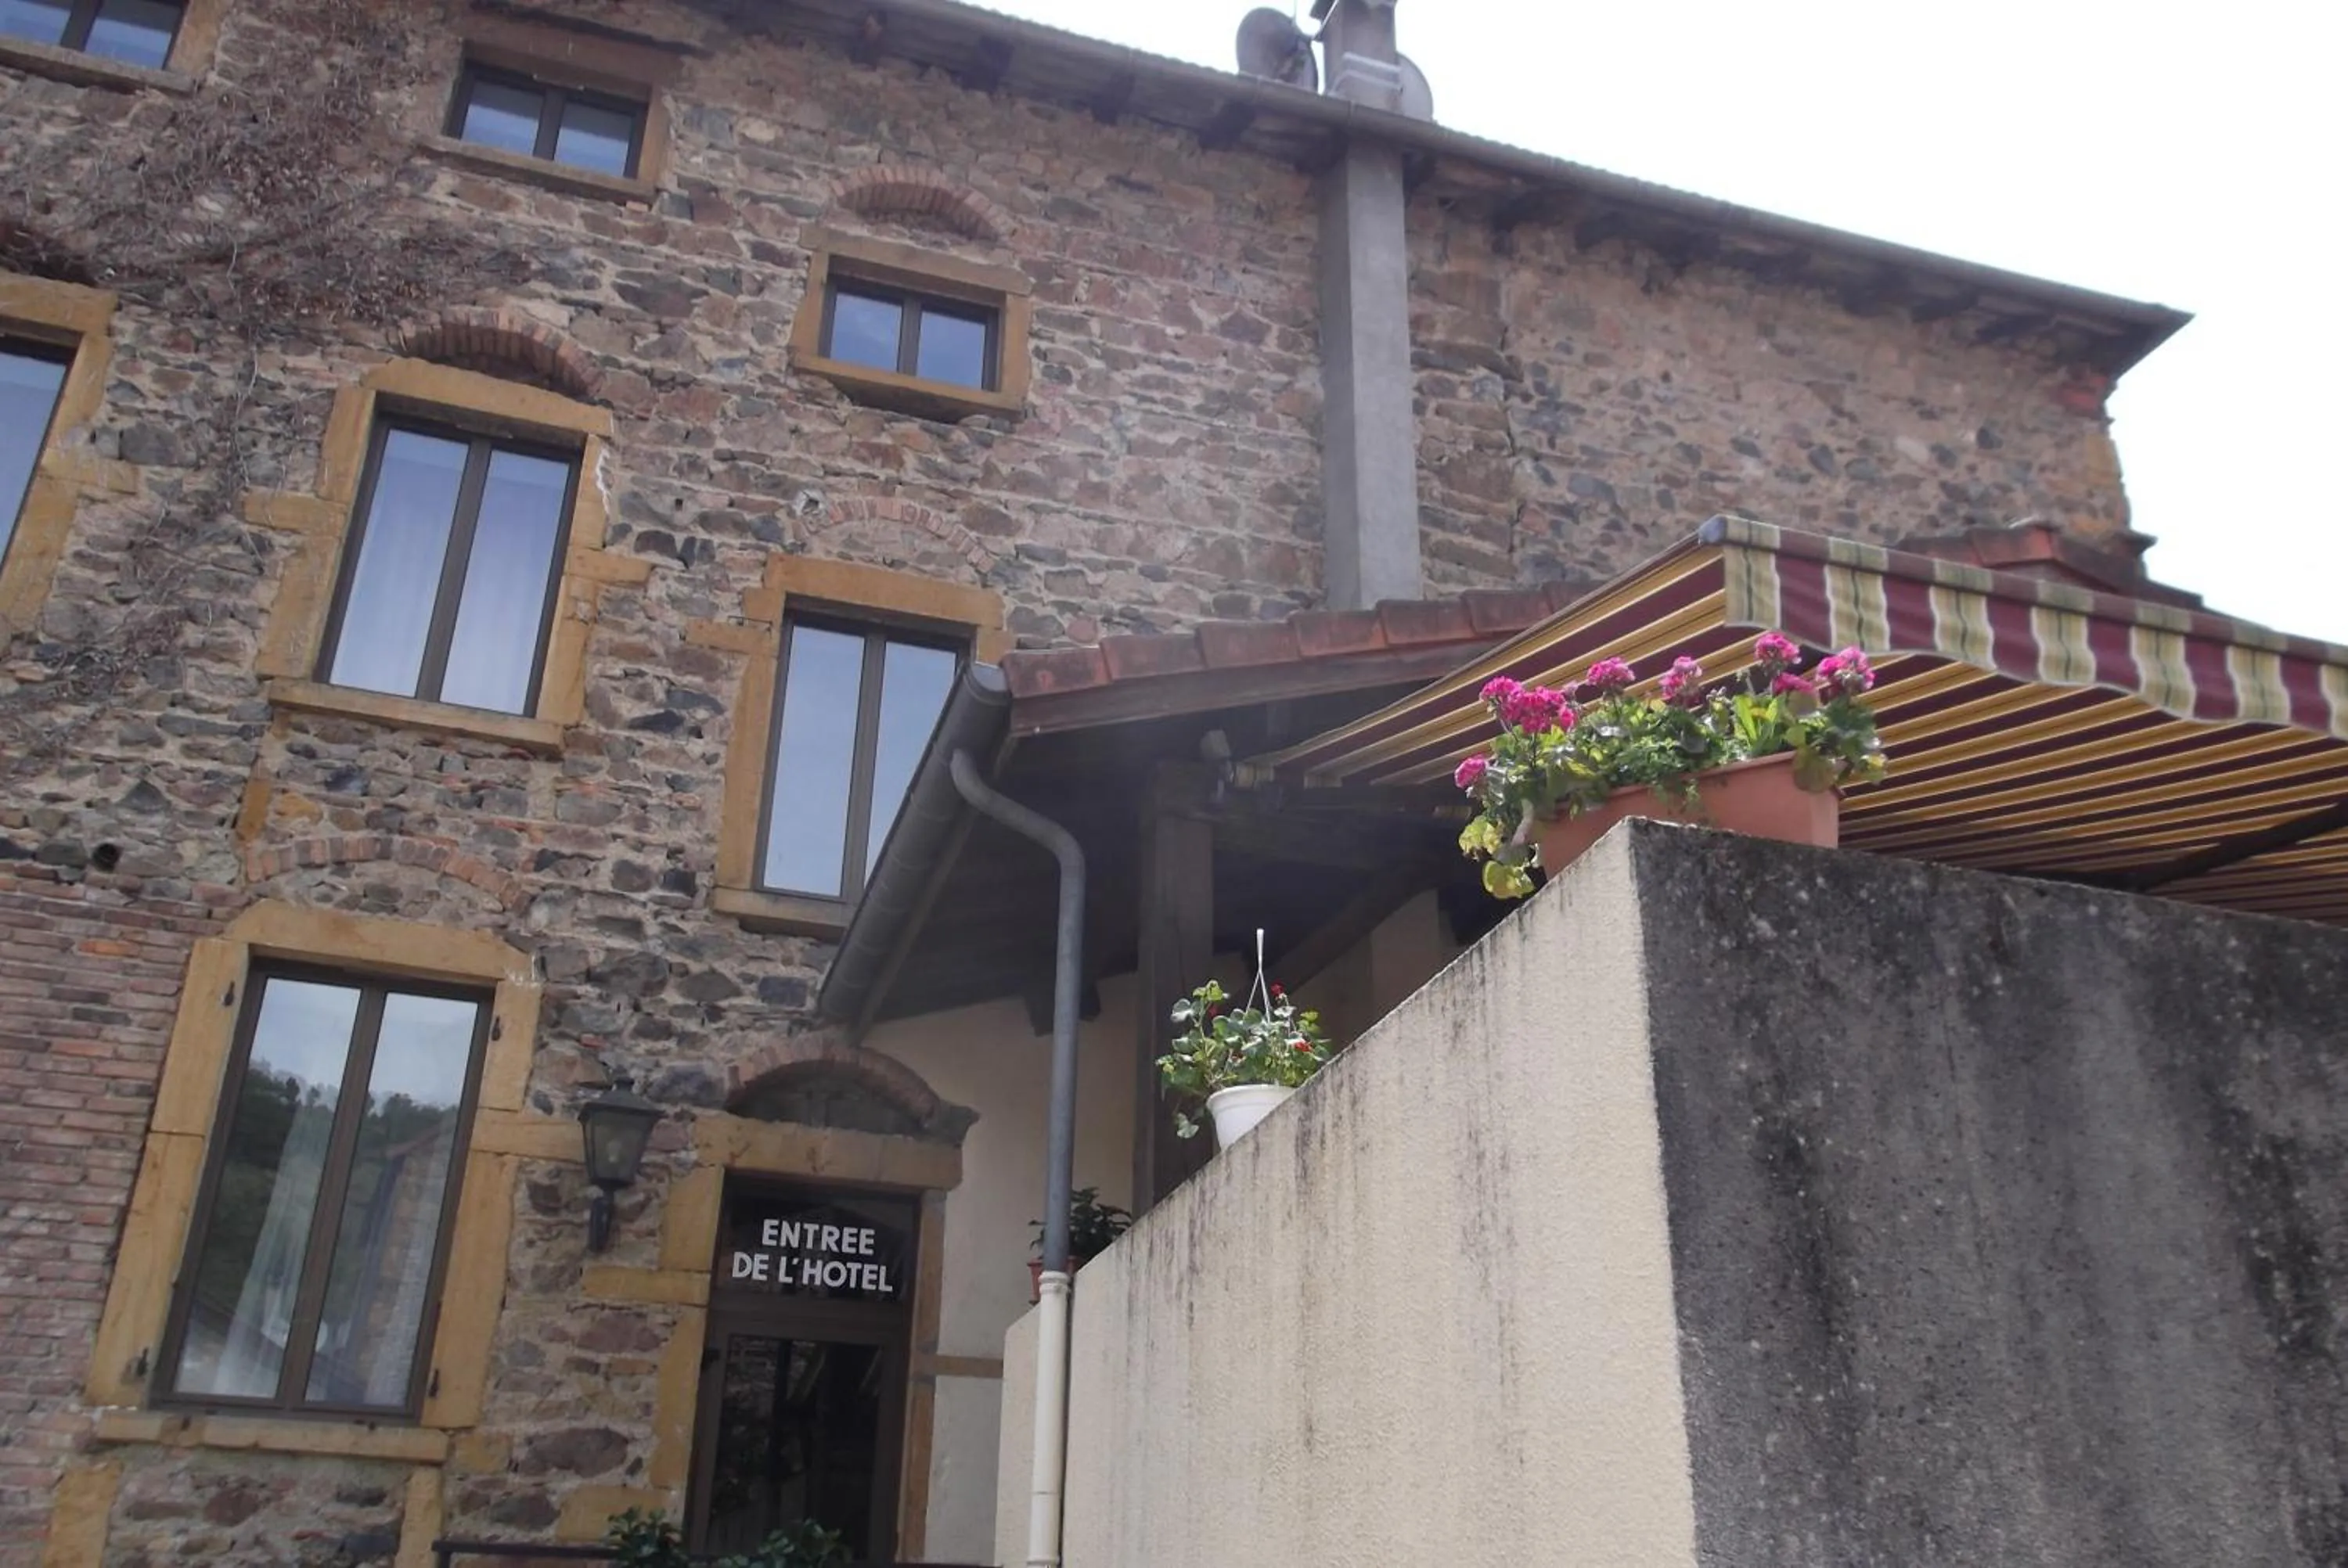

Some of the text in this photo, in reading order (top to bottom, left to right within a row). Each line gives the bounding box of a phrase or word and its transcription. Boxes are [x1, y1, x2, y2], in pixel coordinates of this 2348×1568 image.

[762, 1219, 875, 1255] ENTREE
[732, 1252, 893, 1292] DE L'HOTEL
